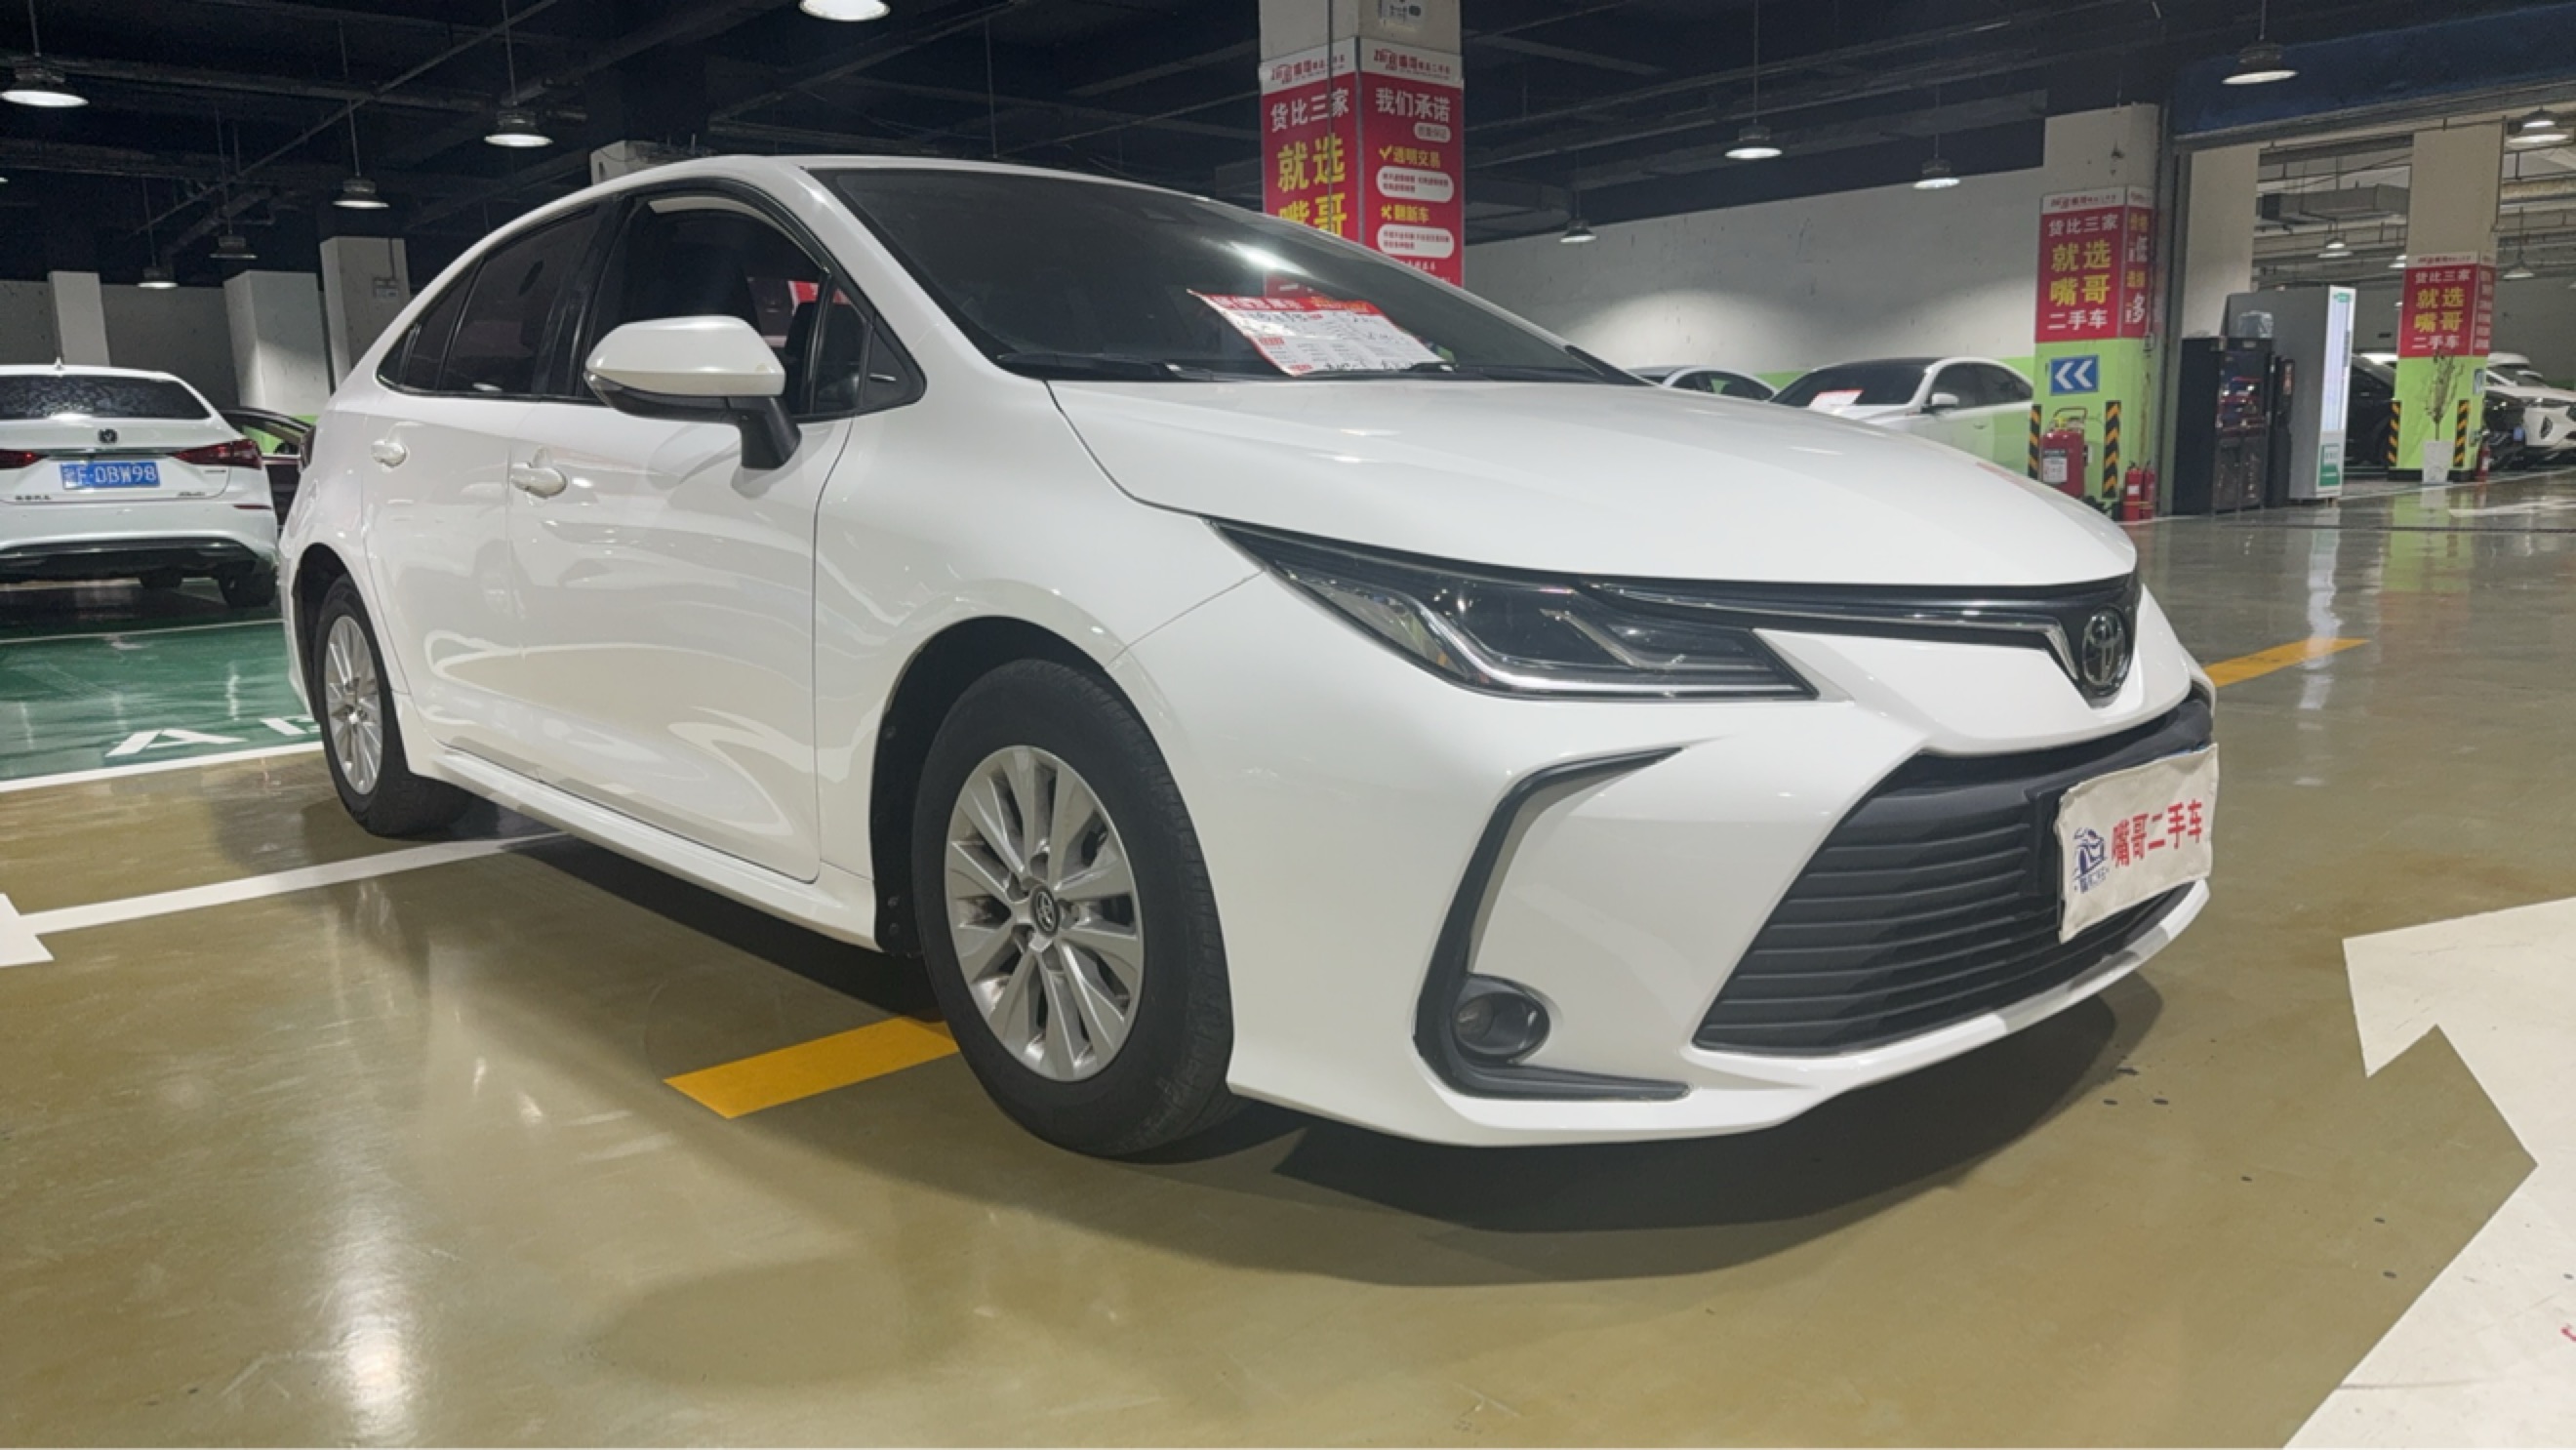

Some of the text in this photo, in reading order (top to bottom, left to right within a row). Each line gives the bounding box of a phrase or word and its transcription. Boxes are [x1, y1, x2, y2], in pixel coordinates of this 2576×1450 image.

[1270, 88, 1349, 133] 货比三家
[1375, 88, 1451, 123] 我们承诺
[1277, 133, 1346, 193] 就选
[2049, 213, 2118, 236] 货比三家
[2051, 238, 2112, 272] 就选
[2050, 273, 2111, 307] 嘴哥
[2416, 287, 2466, 309] 就选
[2047, 308, 2109, 331] 二手车
[2411, 335, 2460, 350] 二手车
[2112, 799, 2202, 868] 嘴哥二手车
